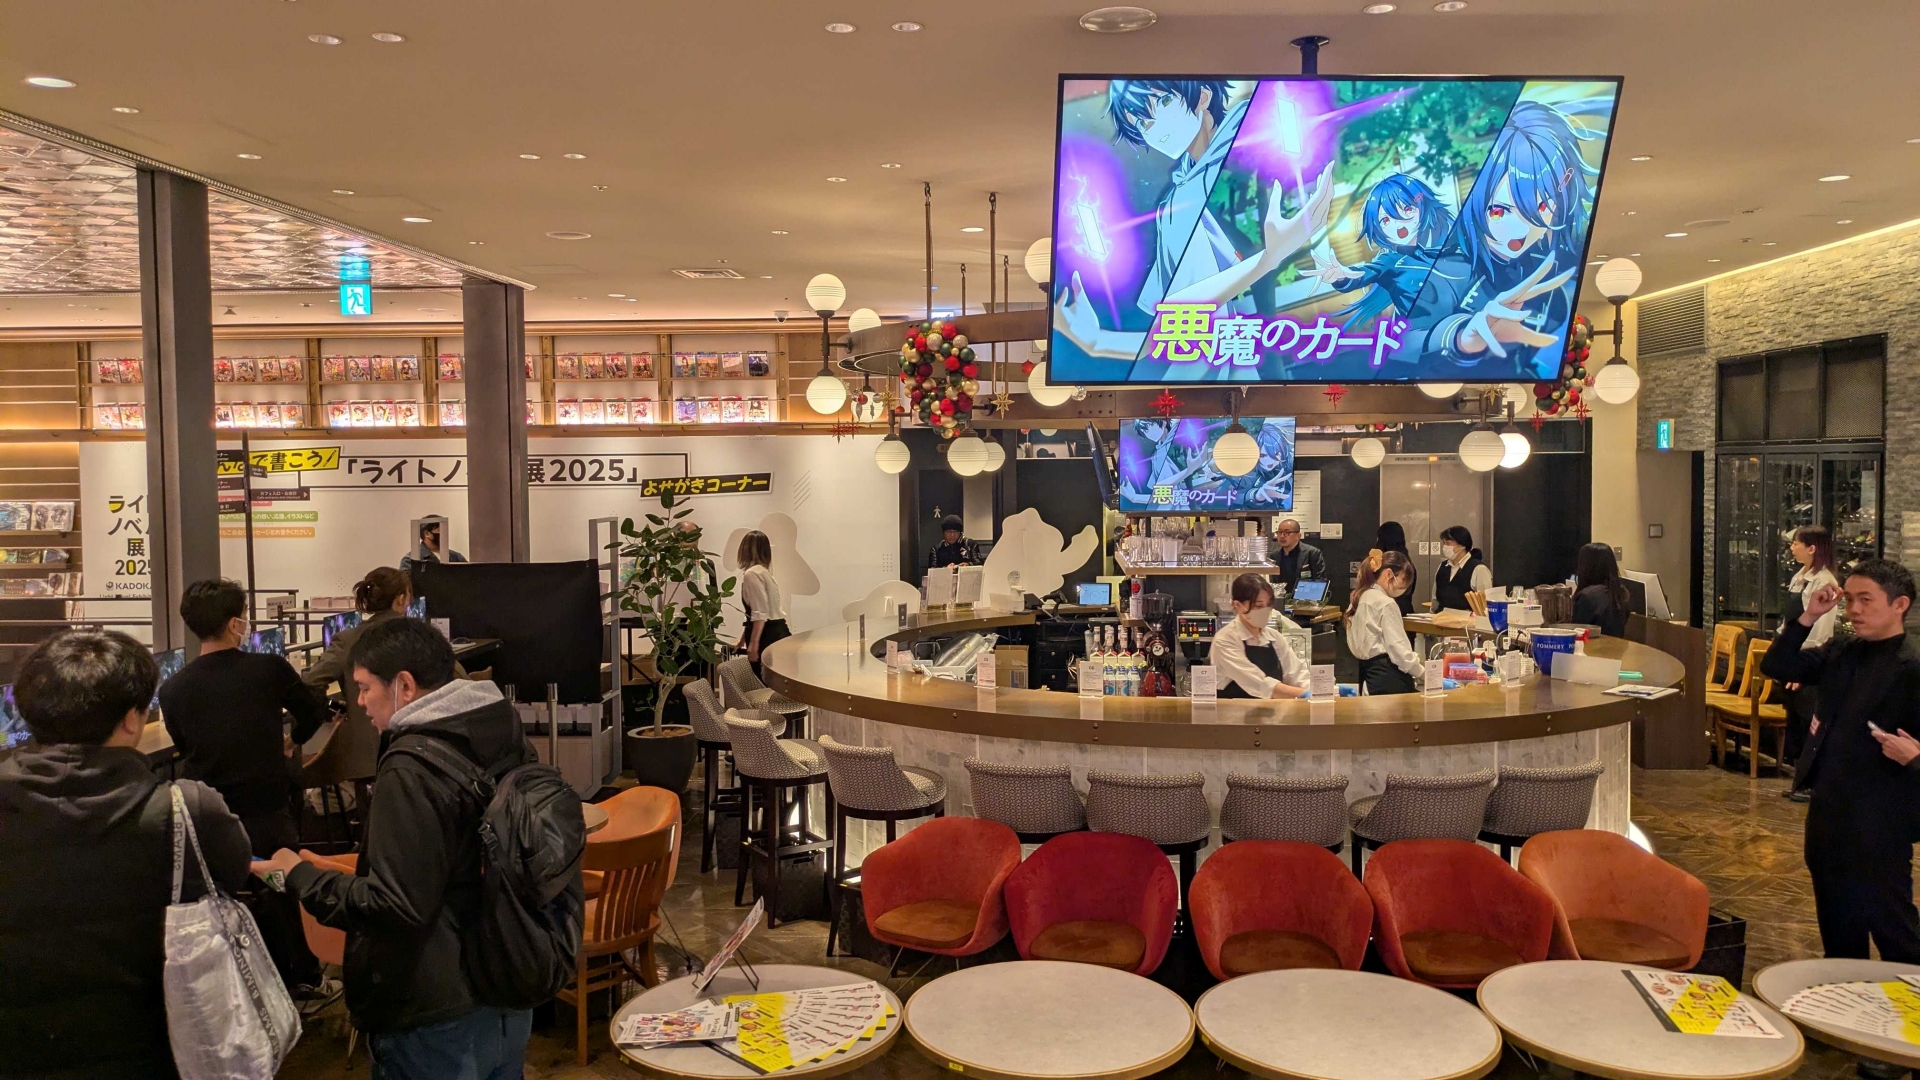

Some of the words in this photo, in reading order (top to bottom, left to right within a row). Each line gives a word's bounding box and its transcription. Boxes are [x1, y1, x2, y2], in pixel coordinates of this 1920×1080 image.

[1152, 303, 1408, 366] 悪魔のカード
[643, 476, 767, 495] よせがきコーナー
[108, 494, 149, 514] ライ
[1153, 485, 1238, 507] 悪魔のカード
[107, 517, 149, 536] ノベ
[127, 538, 145, 557] 展
[115, 582, 151, 590] KADOK
[1536, 642, 1565, 650] POMMERY
